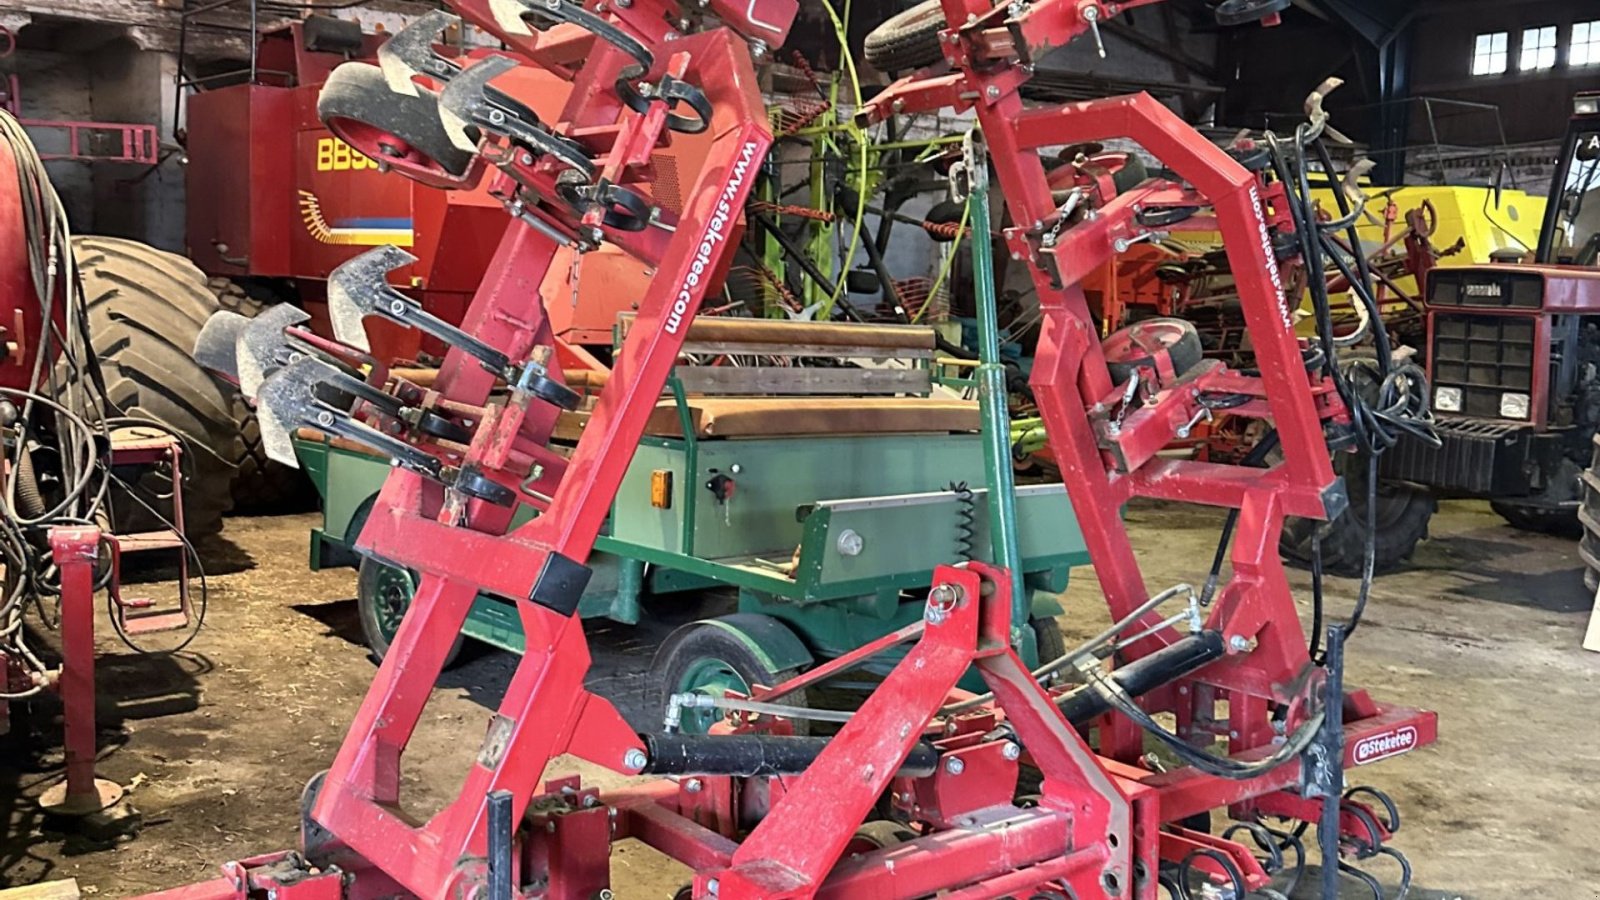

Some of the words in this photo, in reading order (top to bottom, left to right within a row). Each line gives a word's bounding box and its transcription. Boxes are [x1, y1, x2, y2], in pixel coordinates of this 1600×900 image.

[665, 142, 757, 334] www.steketee.com
[1249, 186, 1291, 333] www.steketee.com
[1369, 731, 1412, 755] Steketee
